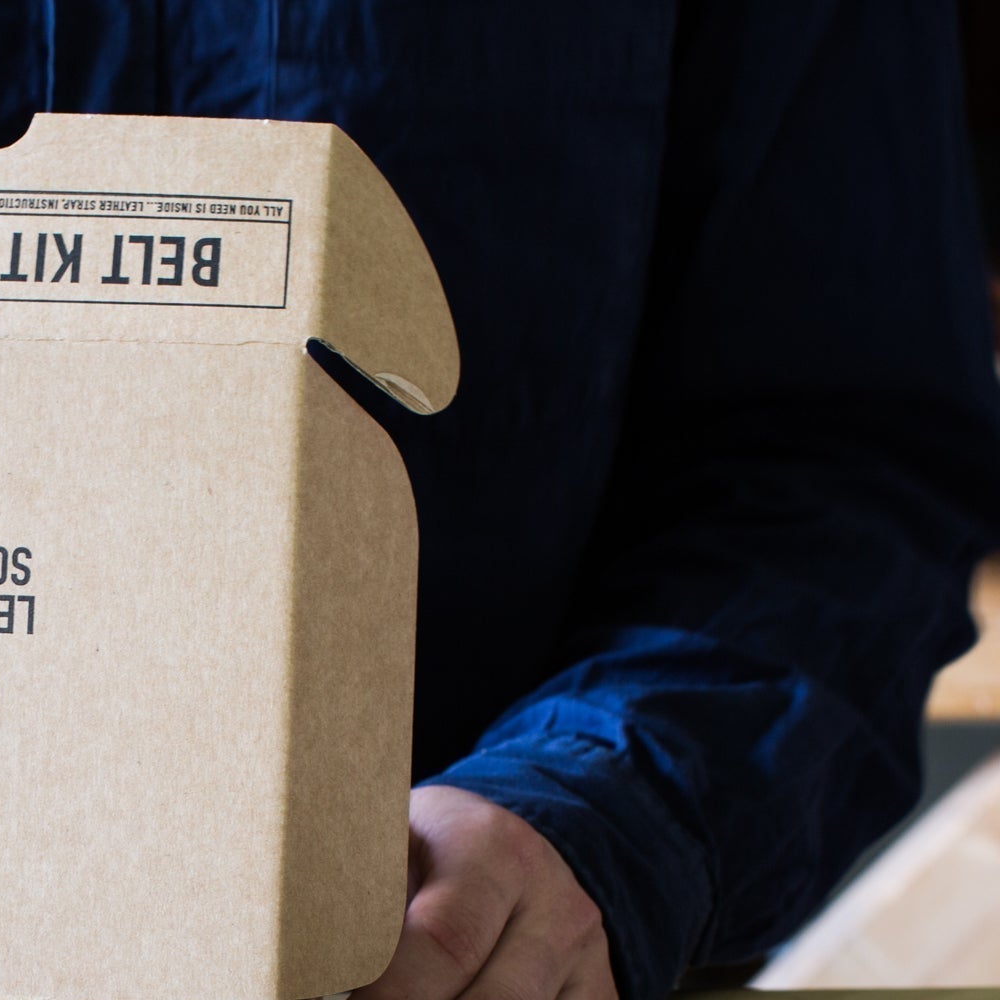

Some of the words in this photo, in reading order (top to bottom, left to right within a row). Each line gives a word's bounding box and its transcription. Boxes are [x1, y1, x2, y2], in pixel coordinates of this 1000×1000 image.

[99, 200, 143, 212] LEATHER
[195, 202, 207, 214] IS
[210, 203, 236, 215] NEED
[239, 204, 260, 216] YOU
[264, 205, 283, 217] ALL
[0, 232, 83, 284] KIT
[101, 234, 222, 288] BELT
